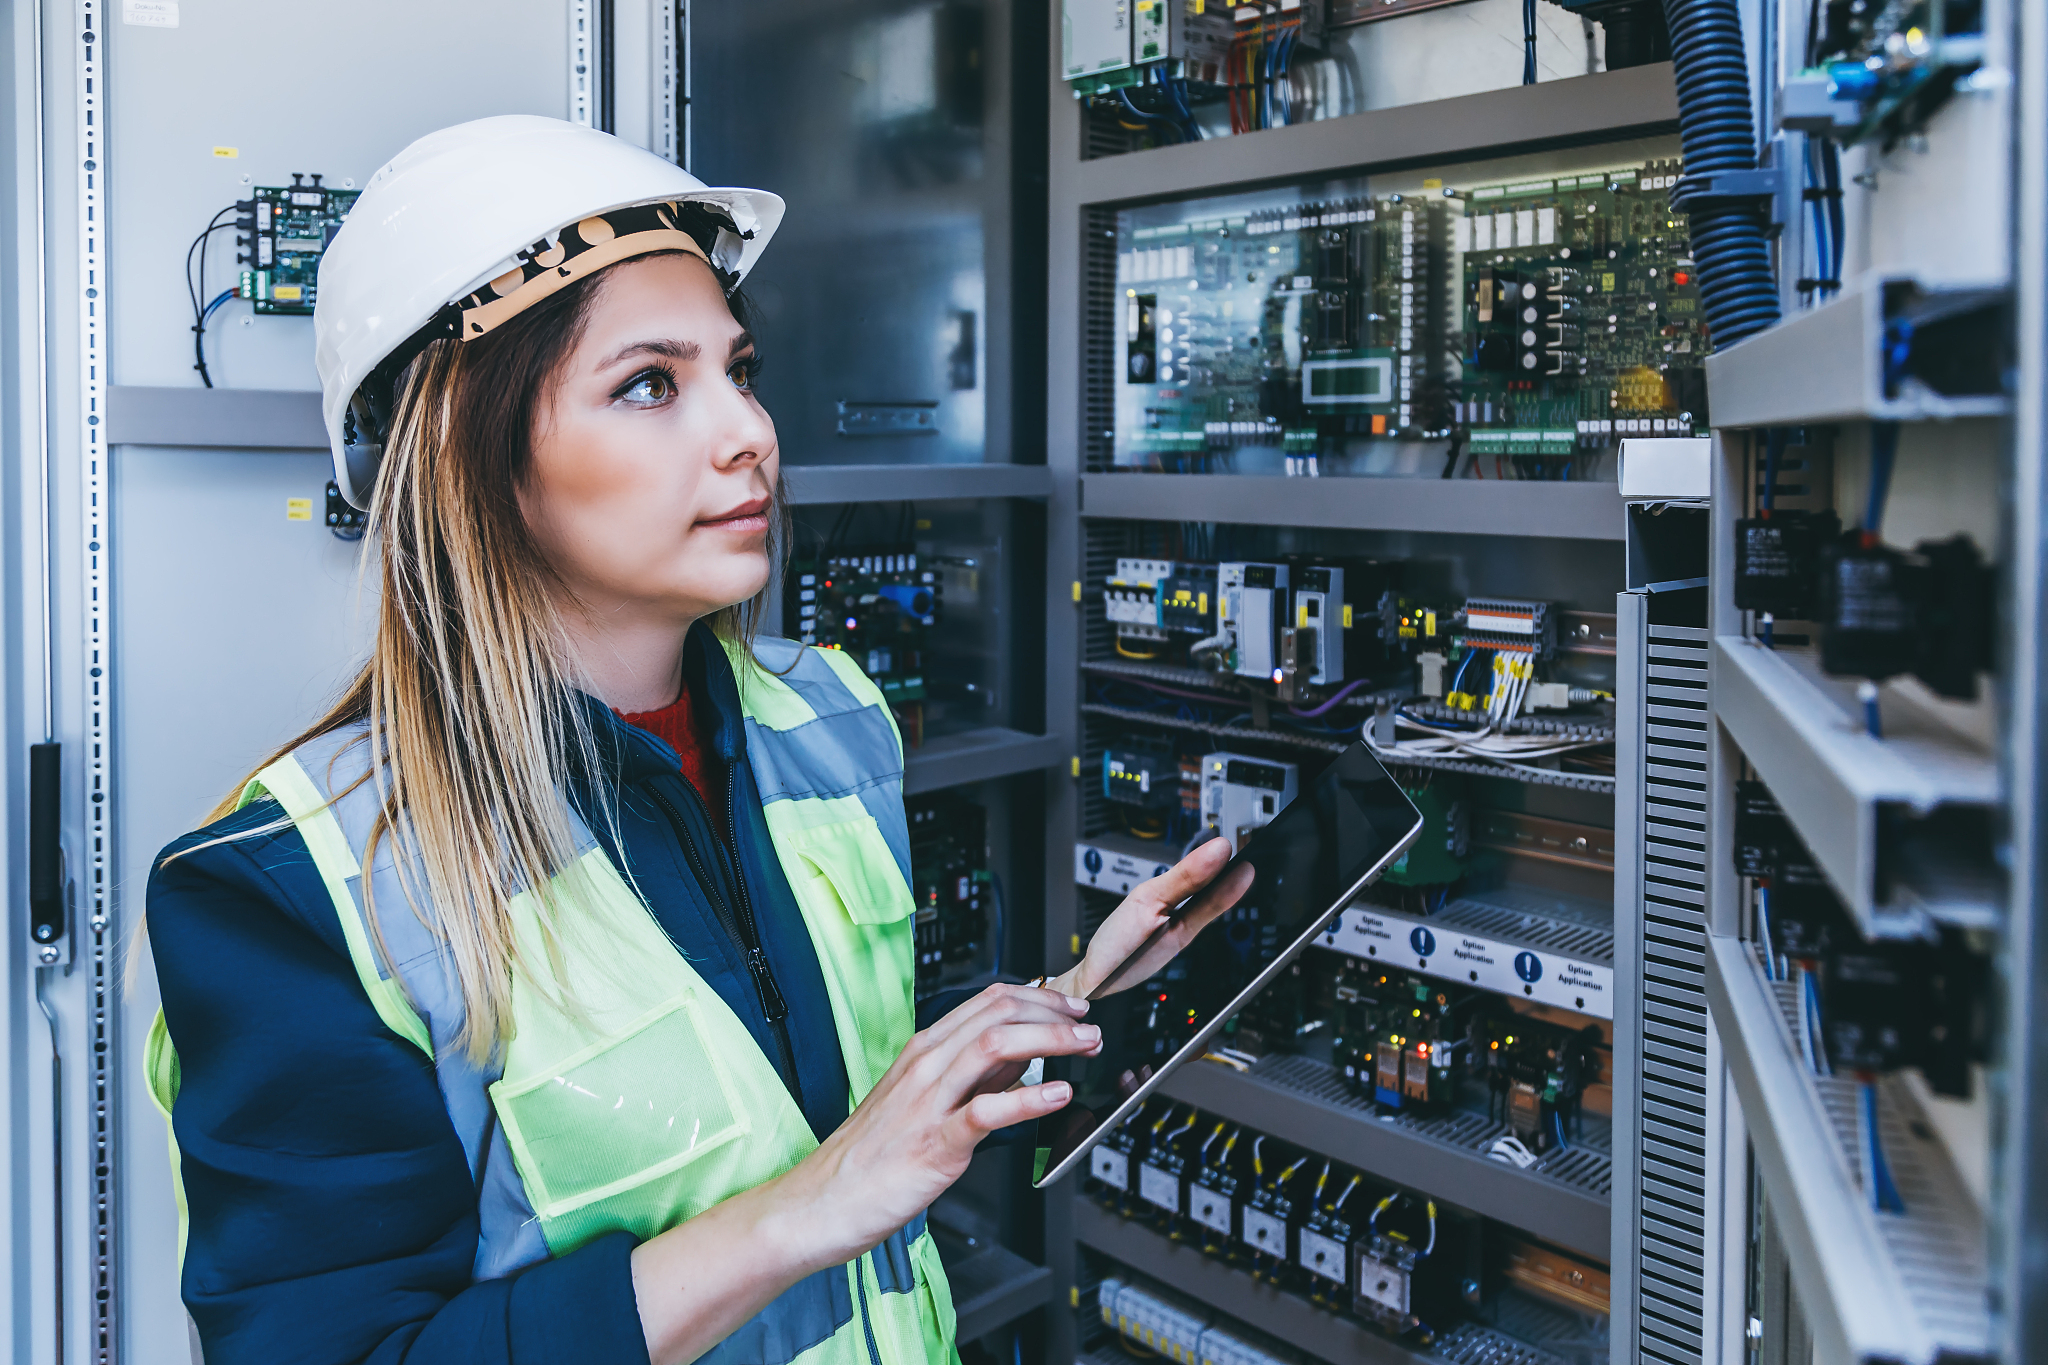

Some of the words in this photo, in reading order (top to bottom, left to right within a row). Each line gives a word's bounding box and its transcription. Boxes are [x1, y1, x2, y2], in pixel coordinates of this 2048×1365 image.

[1362, 915, 1384, 927] Option
[1354, 925, 1392, 940] Application
[1462, 939, 1486, 951] Option
[1454, 948, 1495, 965] Application
[1568, 963, 1593, 977] Option
[1558, 974, 1603, 991] Application
